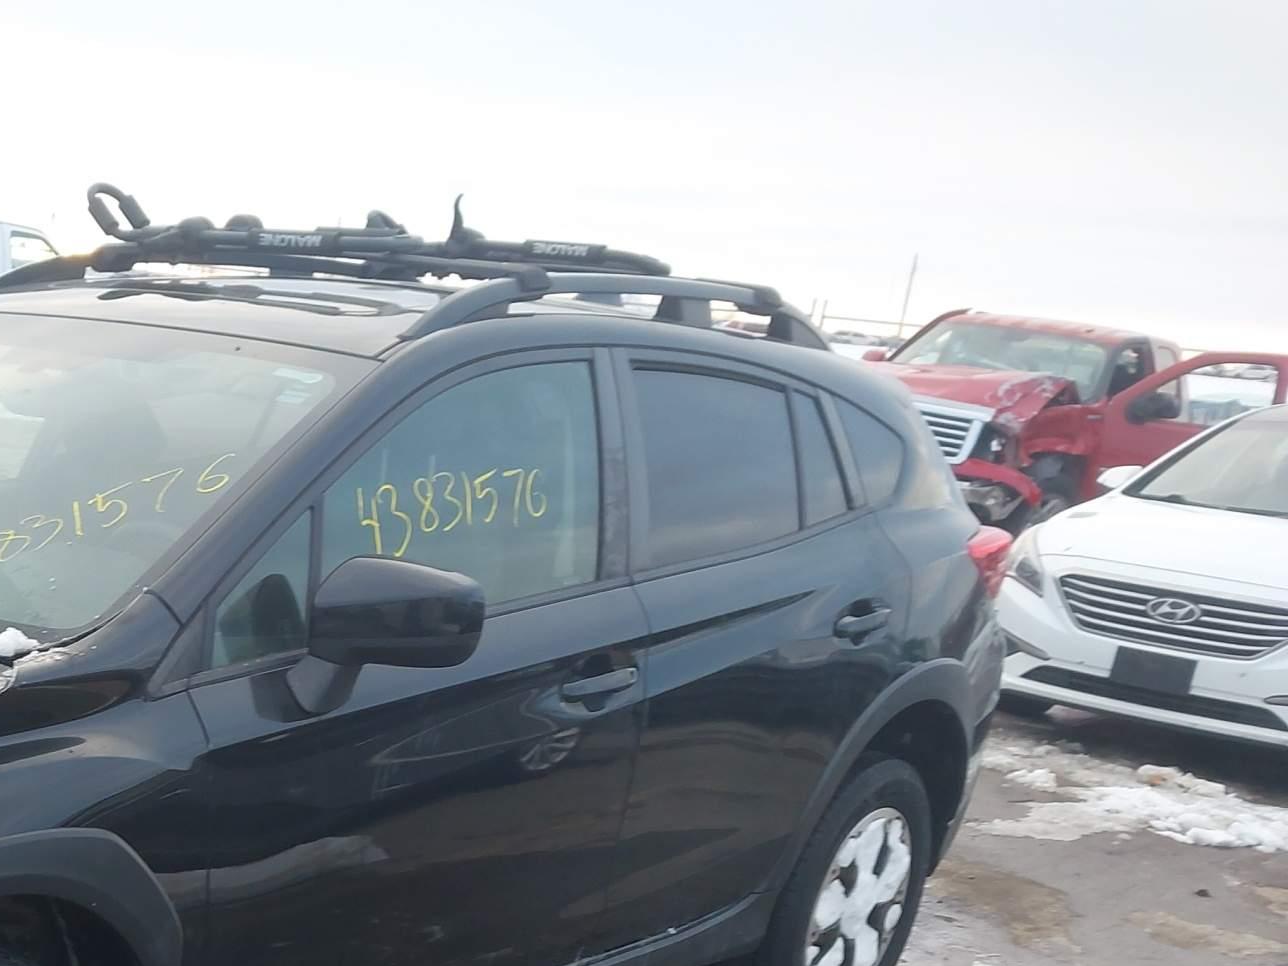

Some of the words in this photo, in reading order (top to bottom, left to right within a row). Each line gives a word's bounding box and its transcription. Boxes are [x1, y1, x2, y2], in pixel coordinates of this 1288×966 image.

[259, 233, 322, 247] MALONE
[533, 242, 588, 257] MALONE
[357, 467, 546, 558] 43831576
